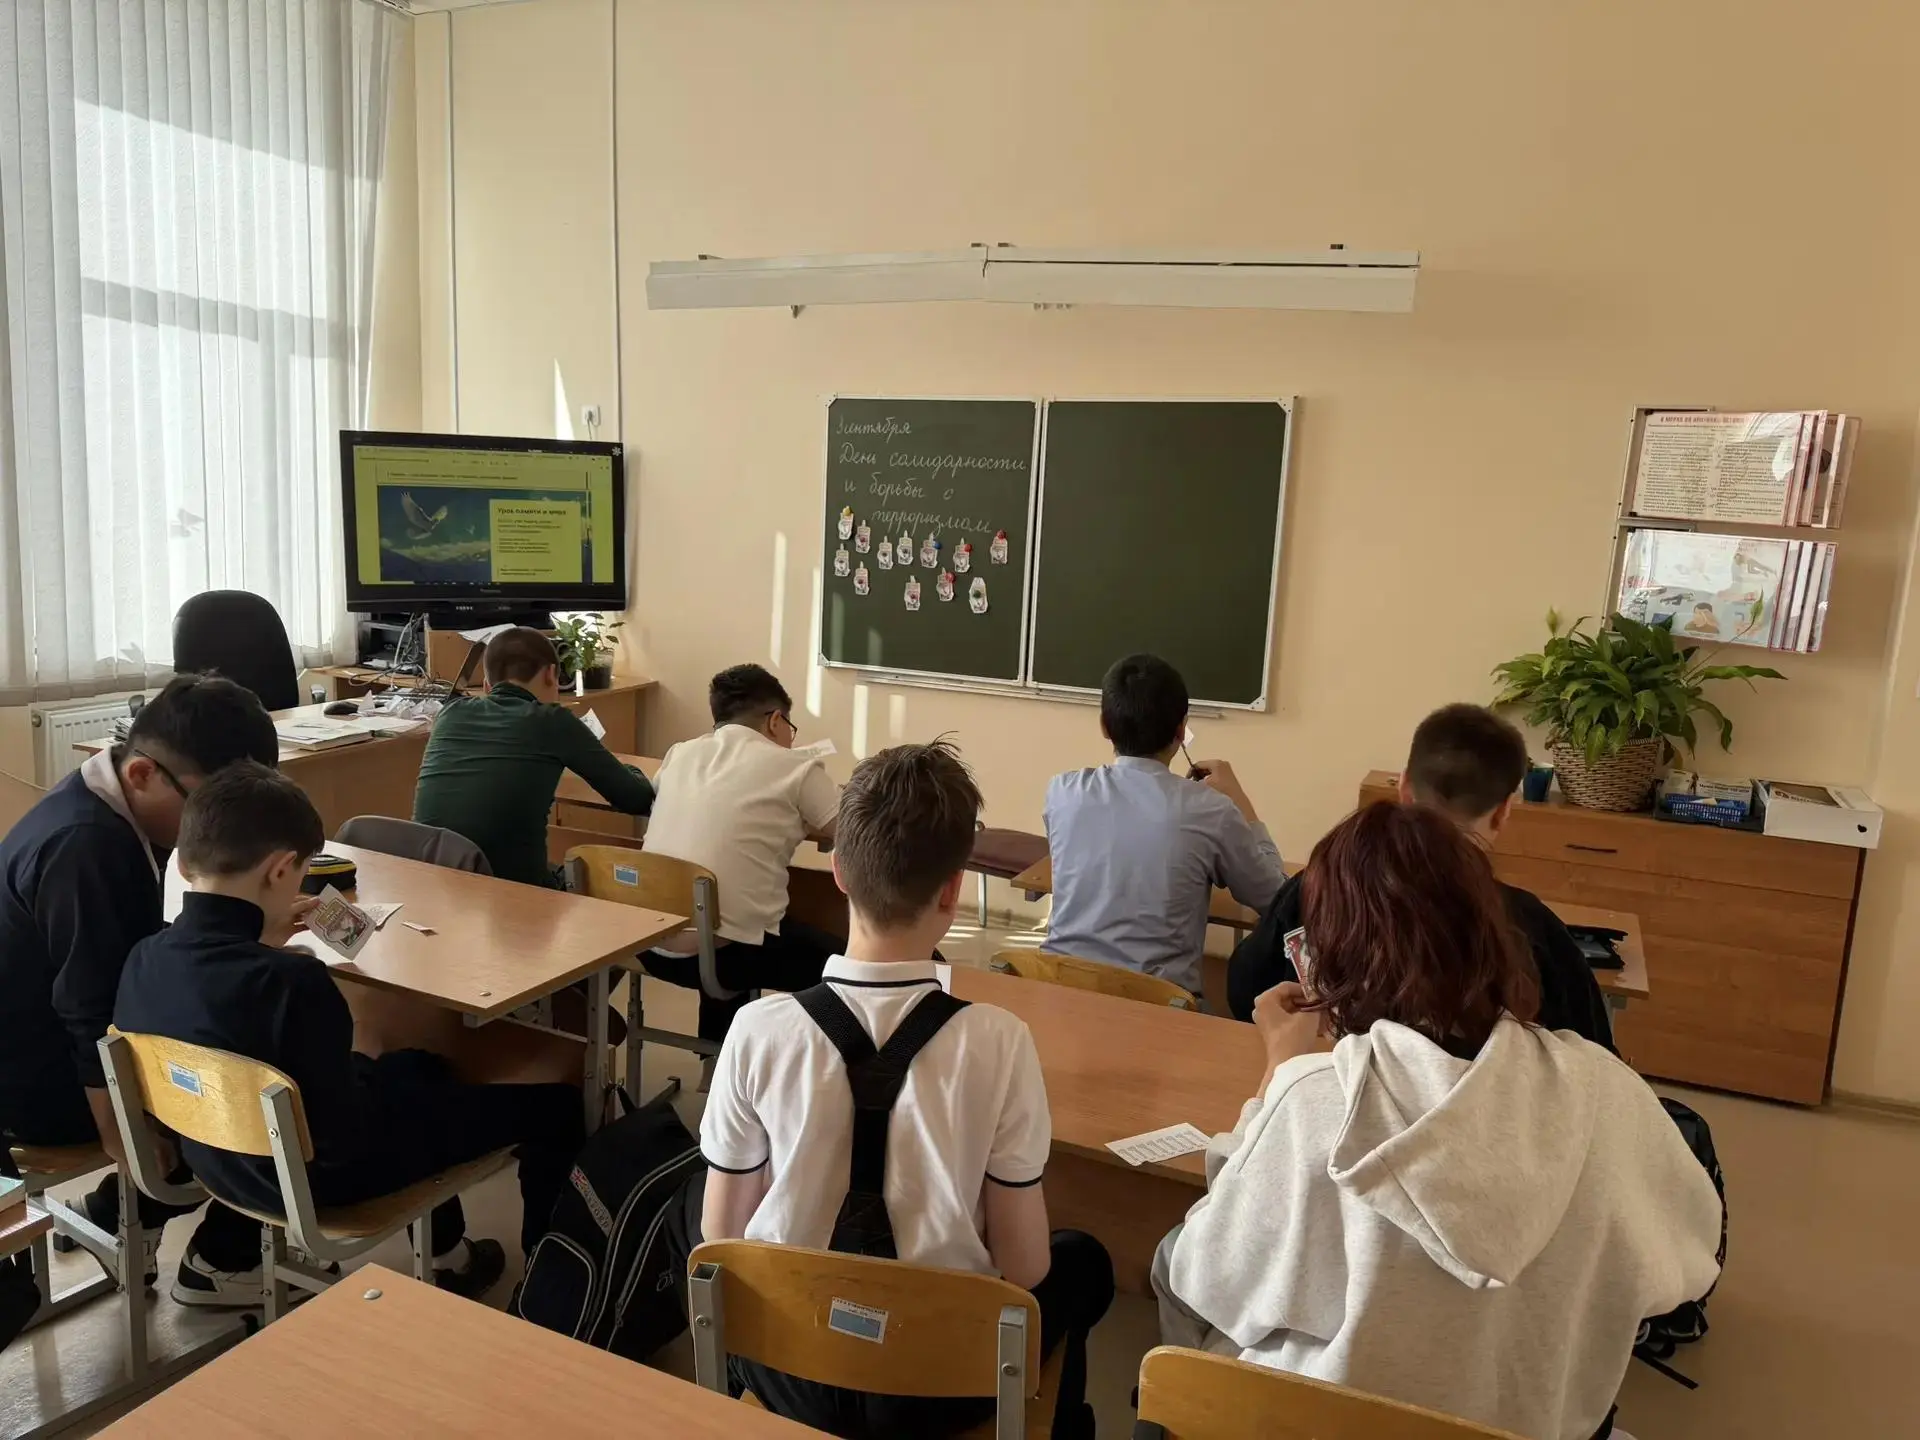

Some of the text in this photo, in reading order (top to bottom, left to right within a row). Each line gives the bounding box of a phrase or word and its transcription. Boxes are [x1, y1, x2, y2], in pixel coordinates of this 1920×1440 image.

[839, 442, 877, 465] День
[844, 472, 954, 507] и борьбы с
[871, 510, 993, 538] терроризмом
